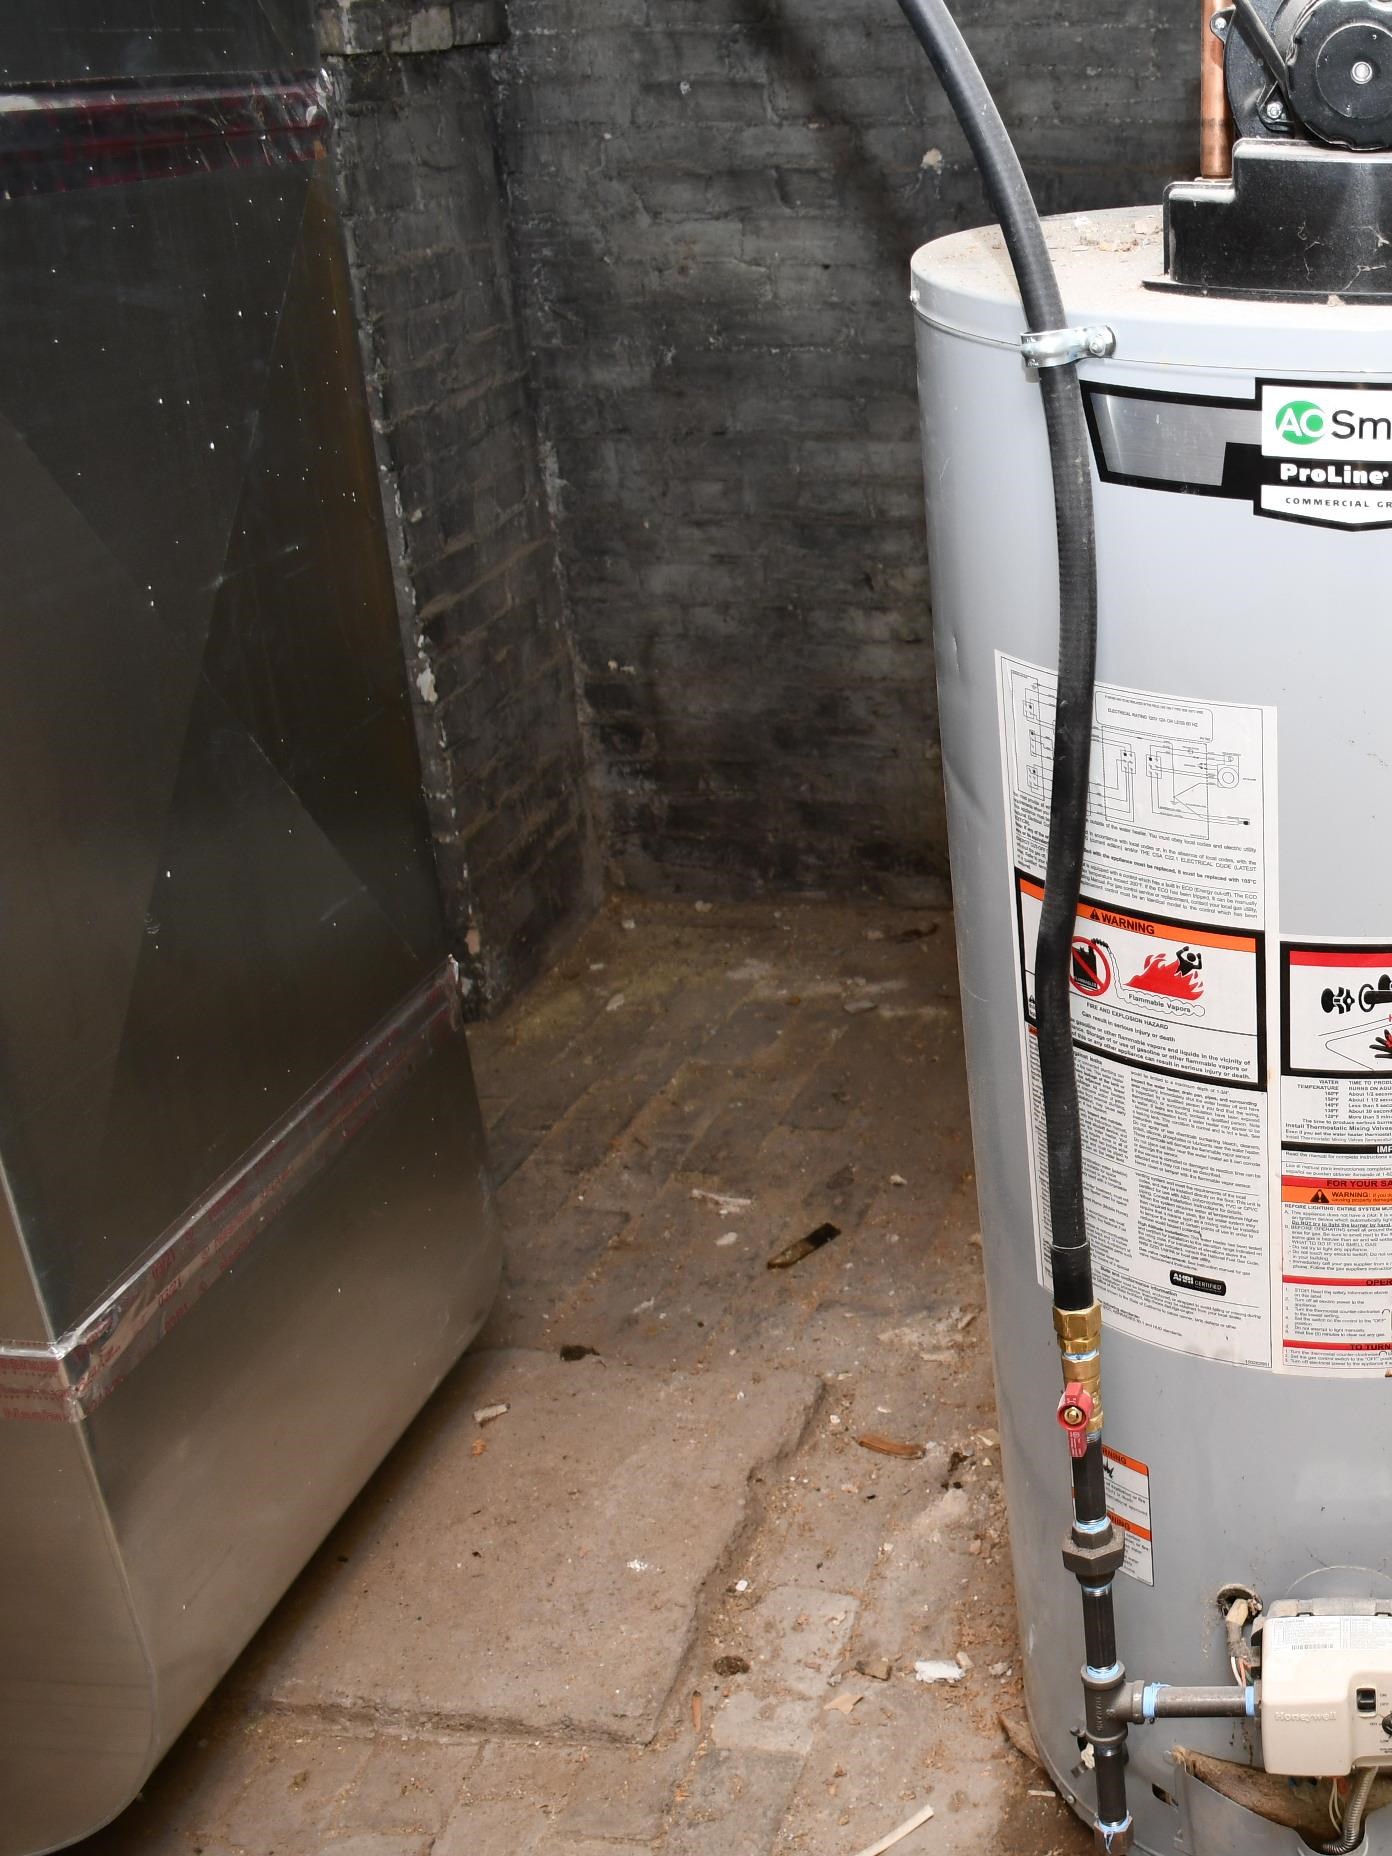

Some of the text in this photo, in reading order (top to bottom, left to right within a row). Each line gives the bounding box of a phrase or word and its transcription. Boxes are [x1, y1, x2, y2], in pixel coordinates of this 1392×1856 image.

[1280, 463, 1384, 485] ProLine
[1285, 498, 1370, 507] COMMERCIAL
[1102, 912, 1155, 934] WARNING
[1129, 994, 1191, 1012] Flammable Vapors
[1112, 1011, 1142, 1023] EXPLOSION
[1144, 1021, 1168, 1029] HAZARD
[1173, 1273, 1222, 1291] AHRI CERTIFIED
[1274, 1712, 1336, 1723] Honeywell
